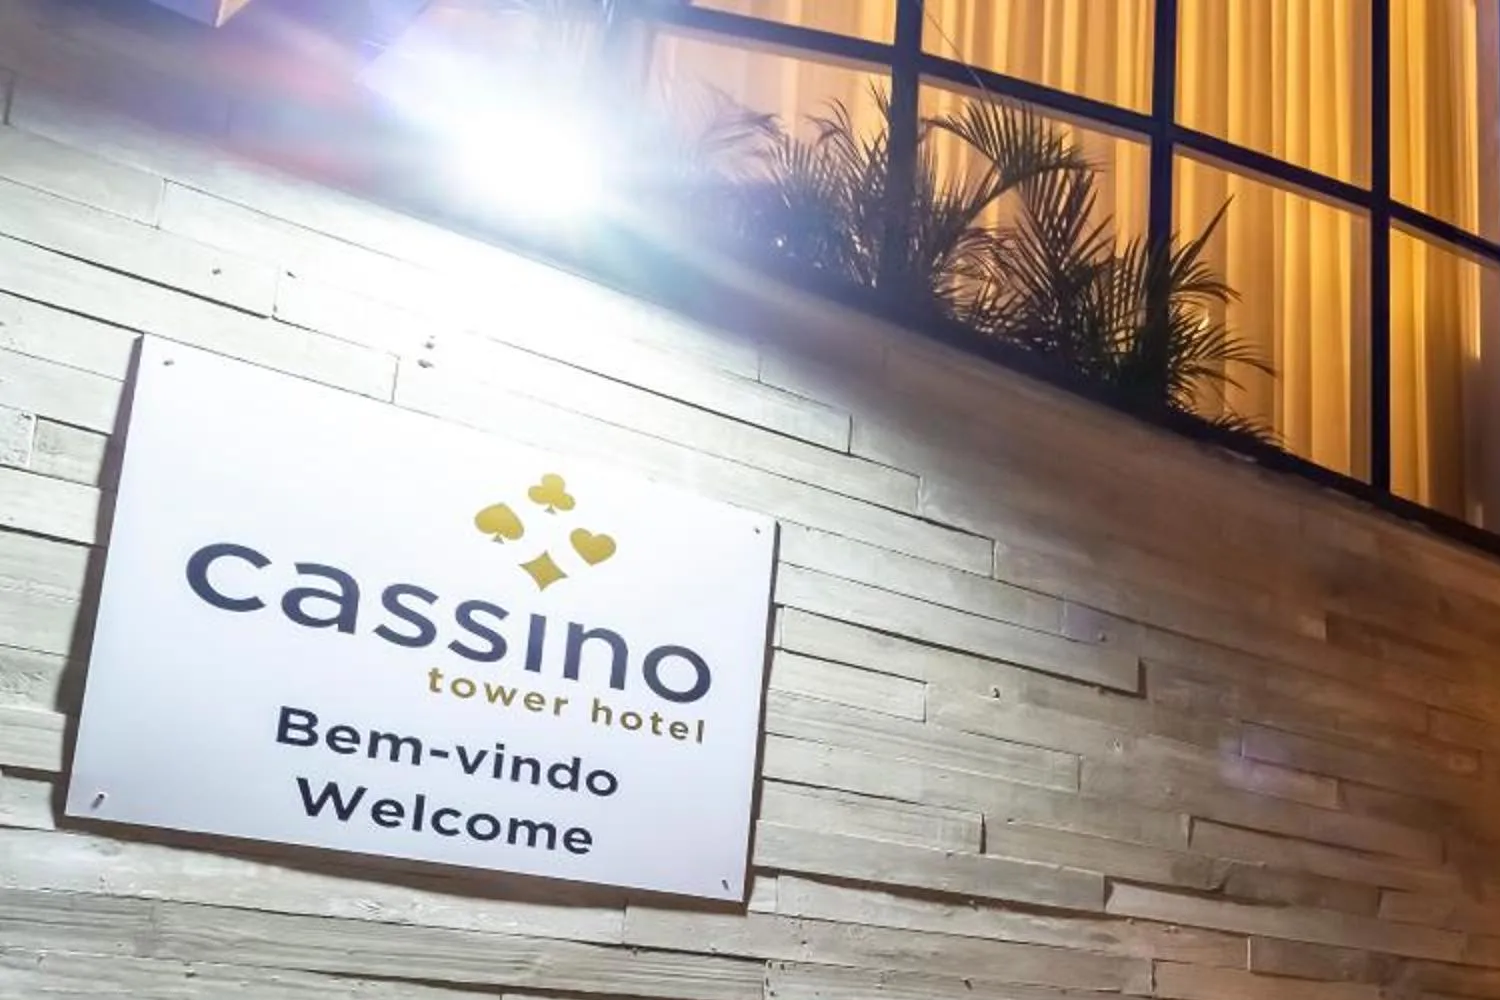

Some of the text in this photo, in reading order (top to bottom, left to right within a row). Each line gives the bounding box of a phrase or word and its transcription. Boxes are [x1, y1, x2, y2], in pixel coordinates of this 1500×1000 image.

[185, 543, 712, 704] cassino
[428, 668, 705, 744] tower hotel
[275, 706, 619, 797] Bem-vindo
[296, 776, 593, 855] Welcome
